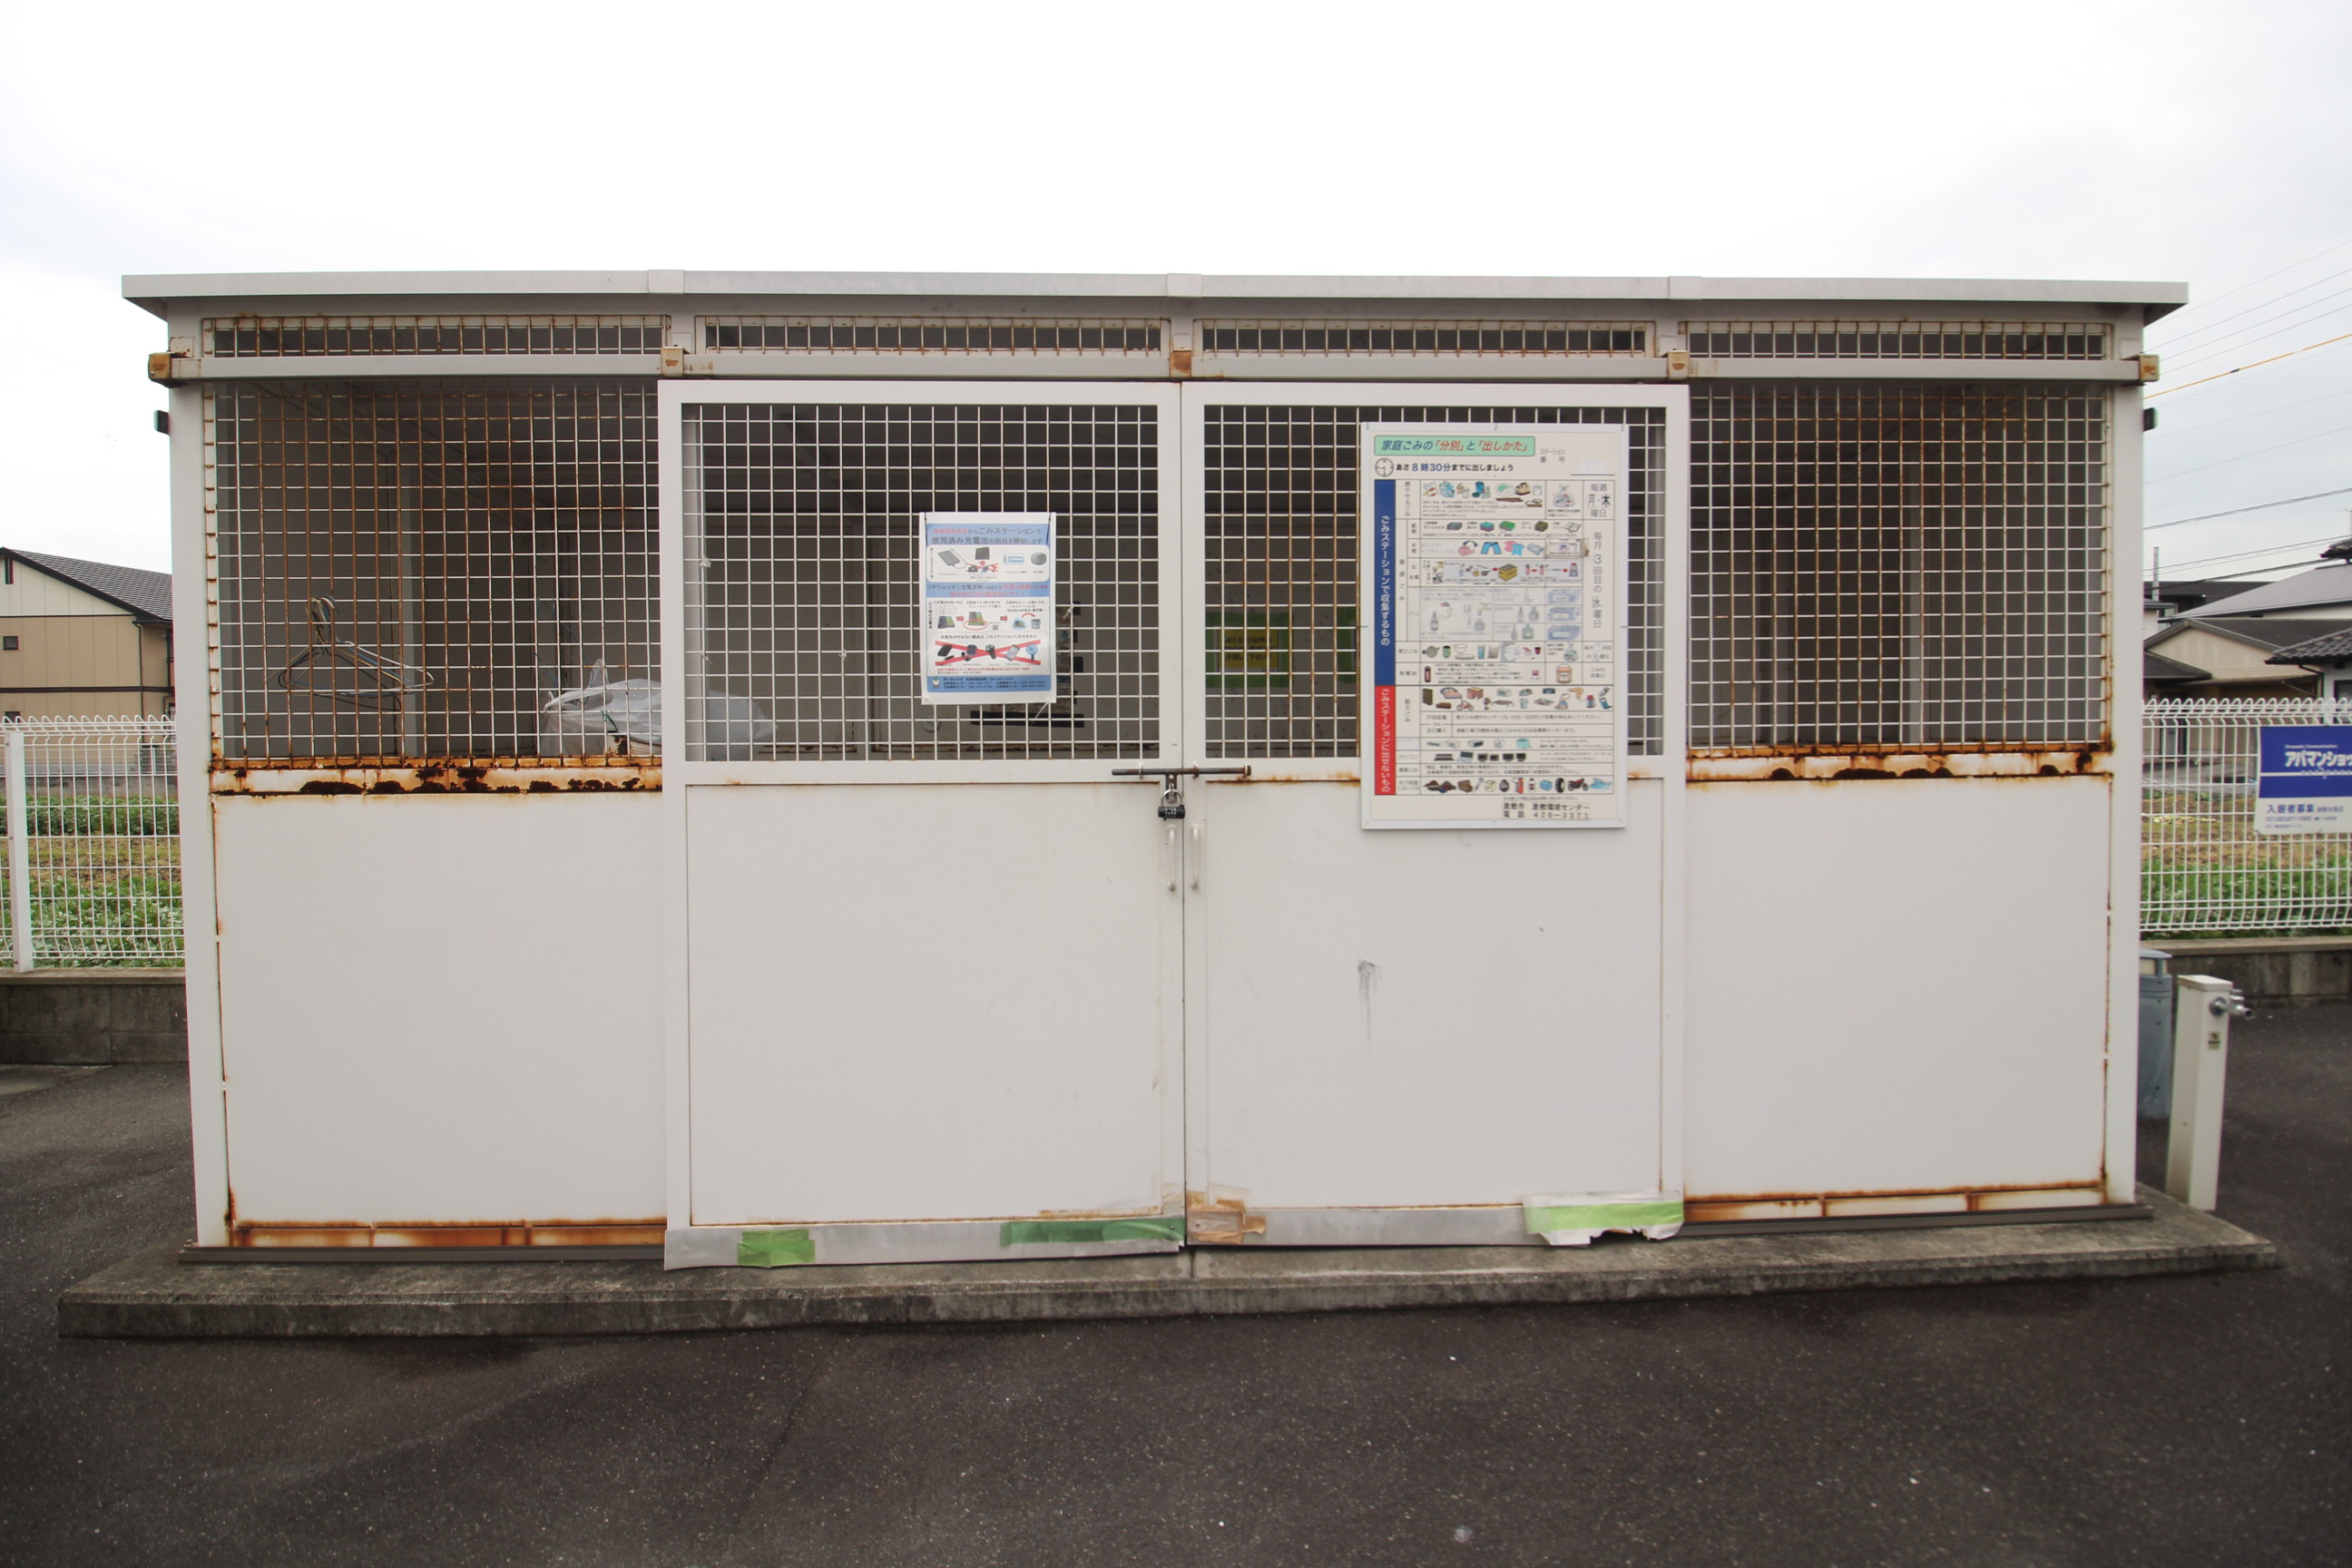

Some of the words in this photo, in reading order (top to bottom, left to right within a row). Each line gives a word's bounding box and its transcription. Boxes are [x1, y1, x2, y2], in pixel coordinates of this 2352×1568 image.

[1381, 440, 1527, 452] 家庭ごみの「分別」と「出しかた」
[1380, 515, 1390, 646] ごみステーションで収集するもの
[1381, 688, 1390, 792] ごみステーションに出せないもの
[2267, 804, 2315, 814] 入居者募集
